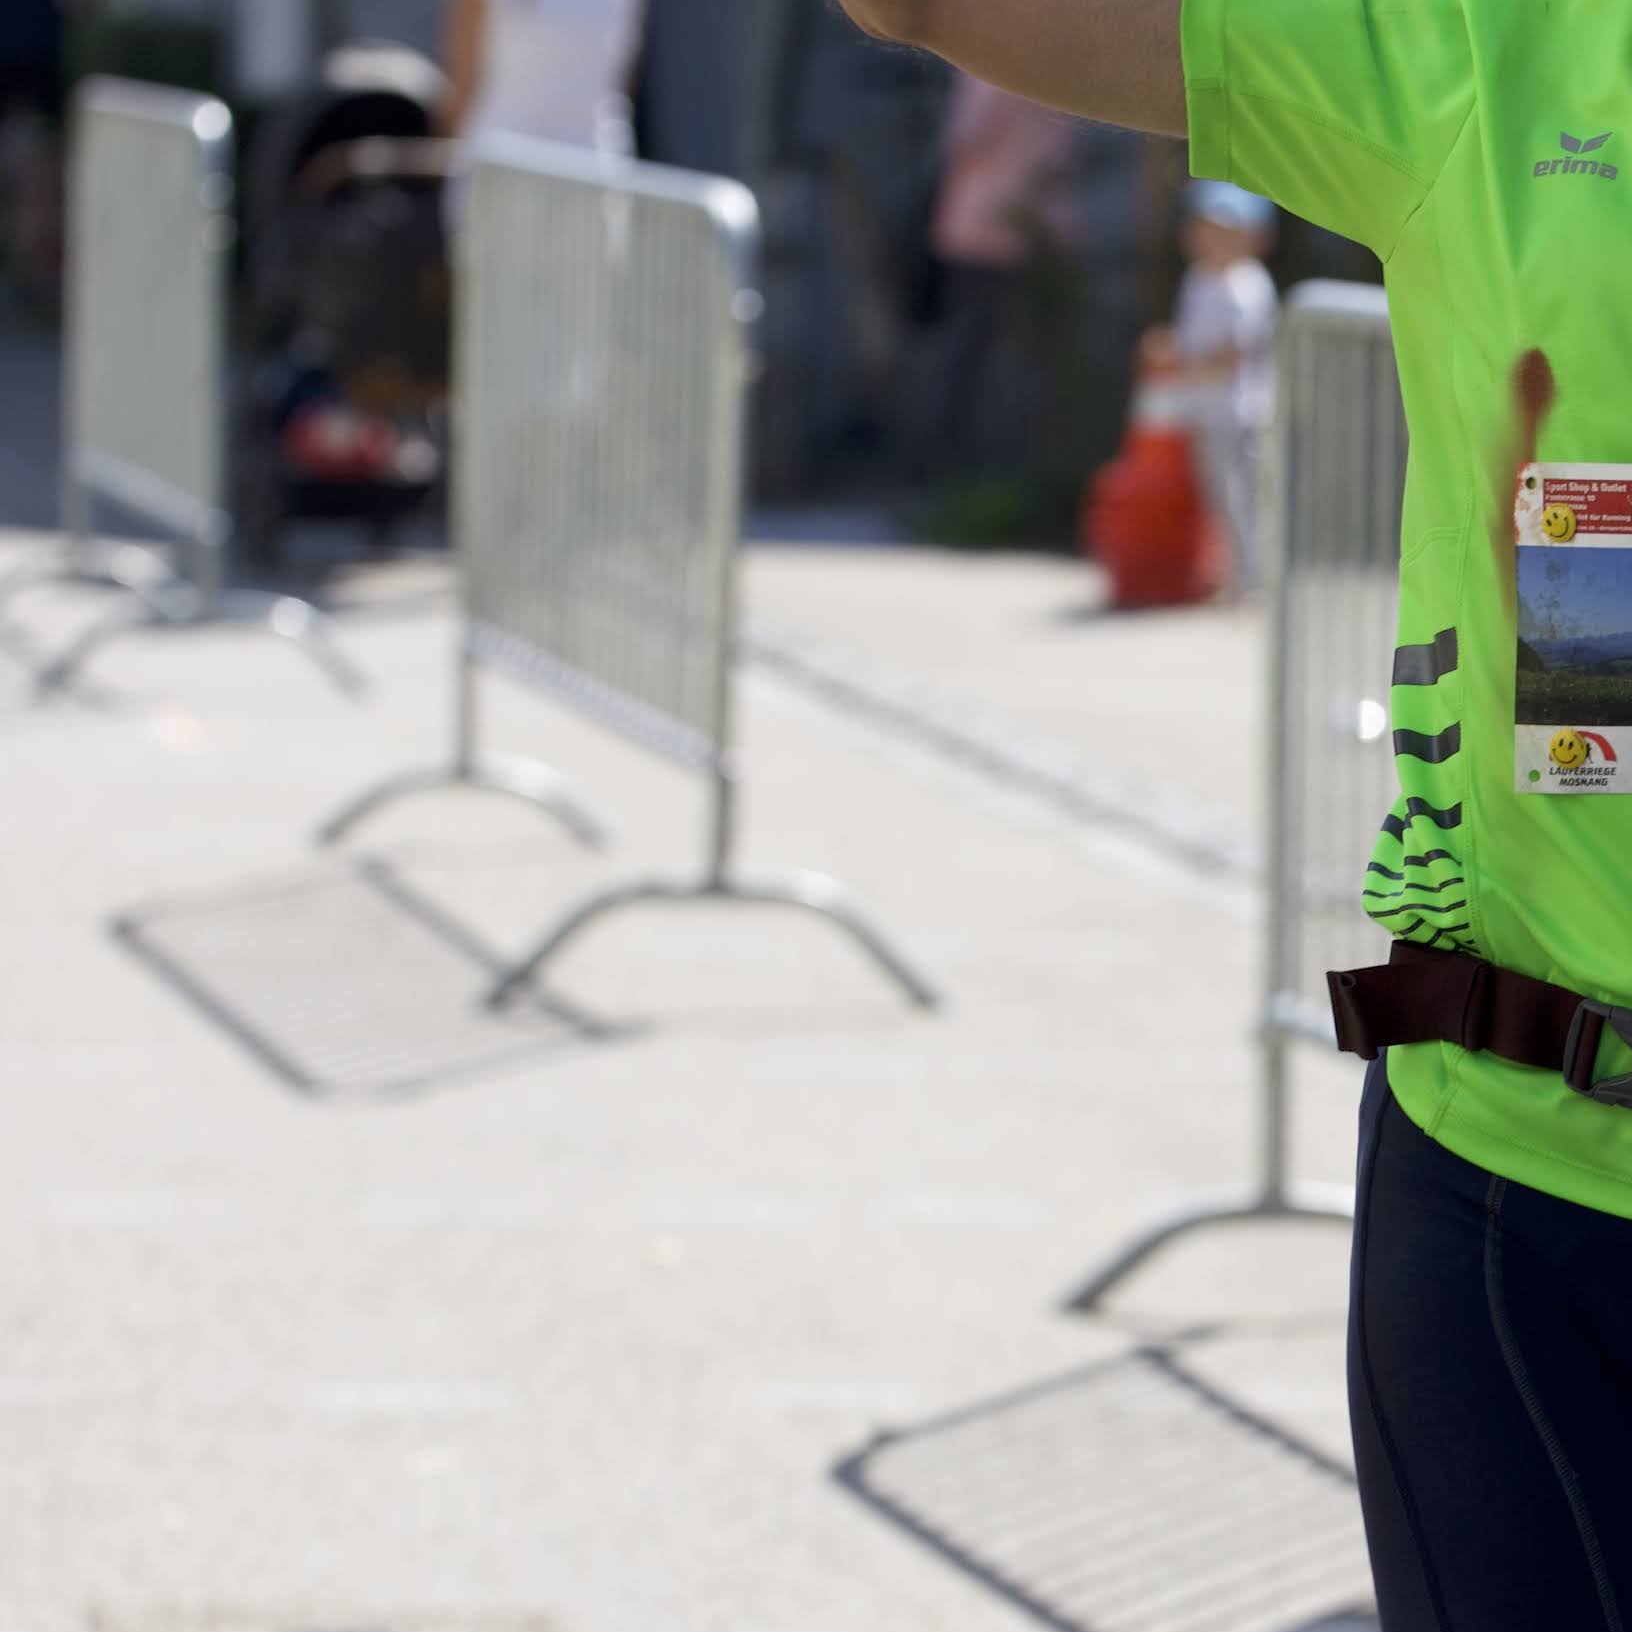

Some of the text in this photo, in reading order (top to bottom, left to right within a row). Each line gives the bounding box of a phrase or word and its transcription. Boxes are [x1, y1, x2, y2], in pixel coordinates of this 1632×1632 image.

[1533, 155, 1618, 180] erima
[1568, 481, 1590, 494] Shop
[1591, 482, 1599, 493] &
[1600, 482, 1627, 493] Outlet
[1559, 777, 1609, 787] MOSNANG
